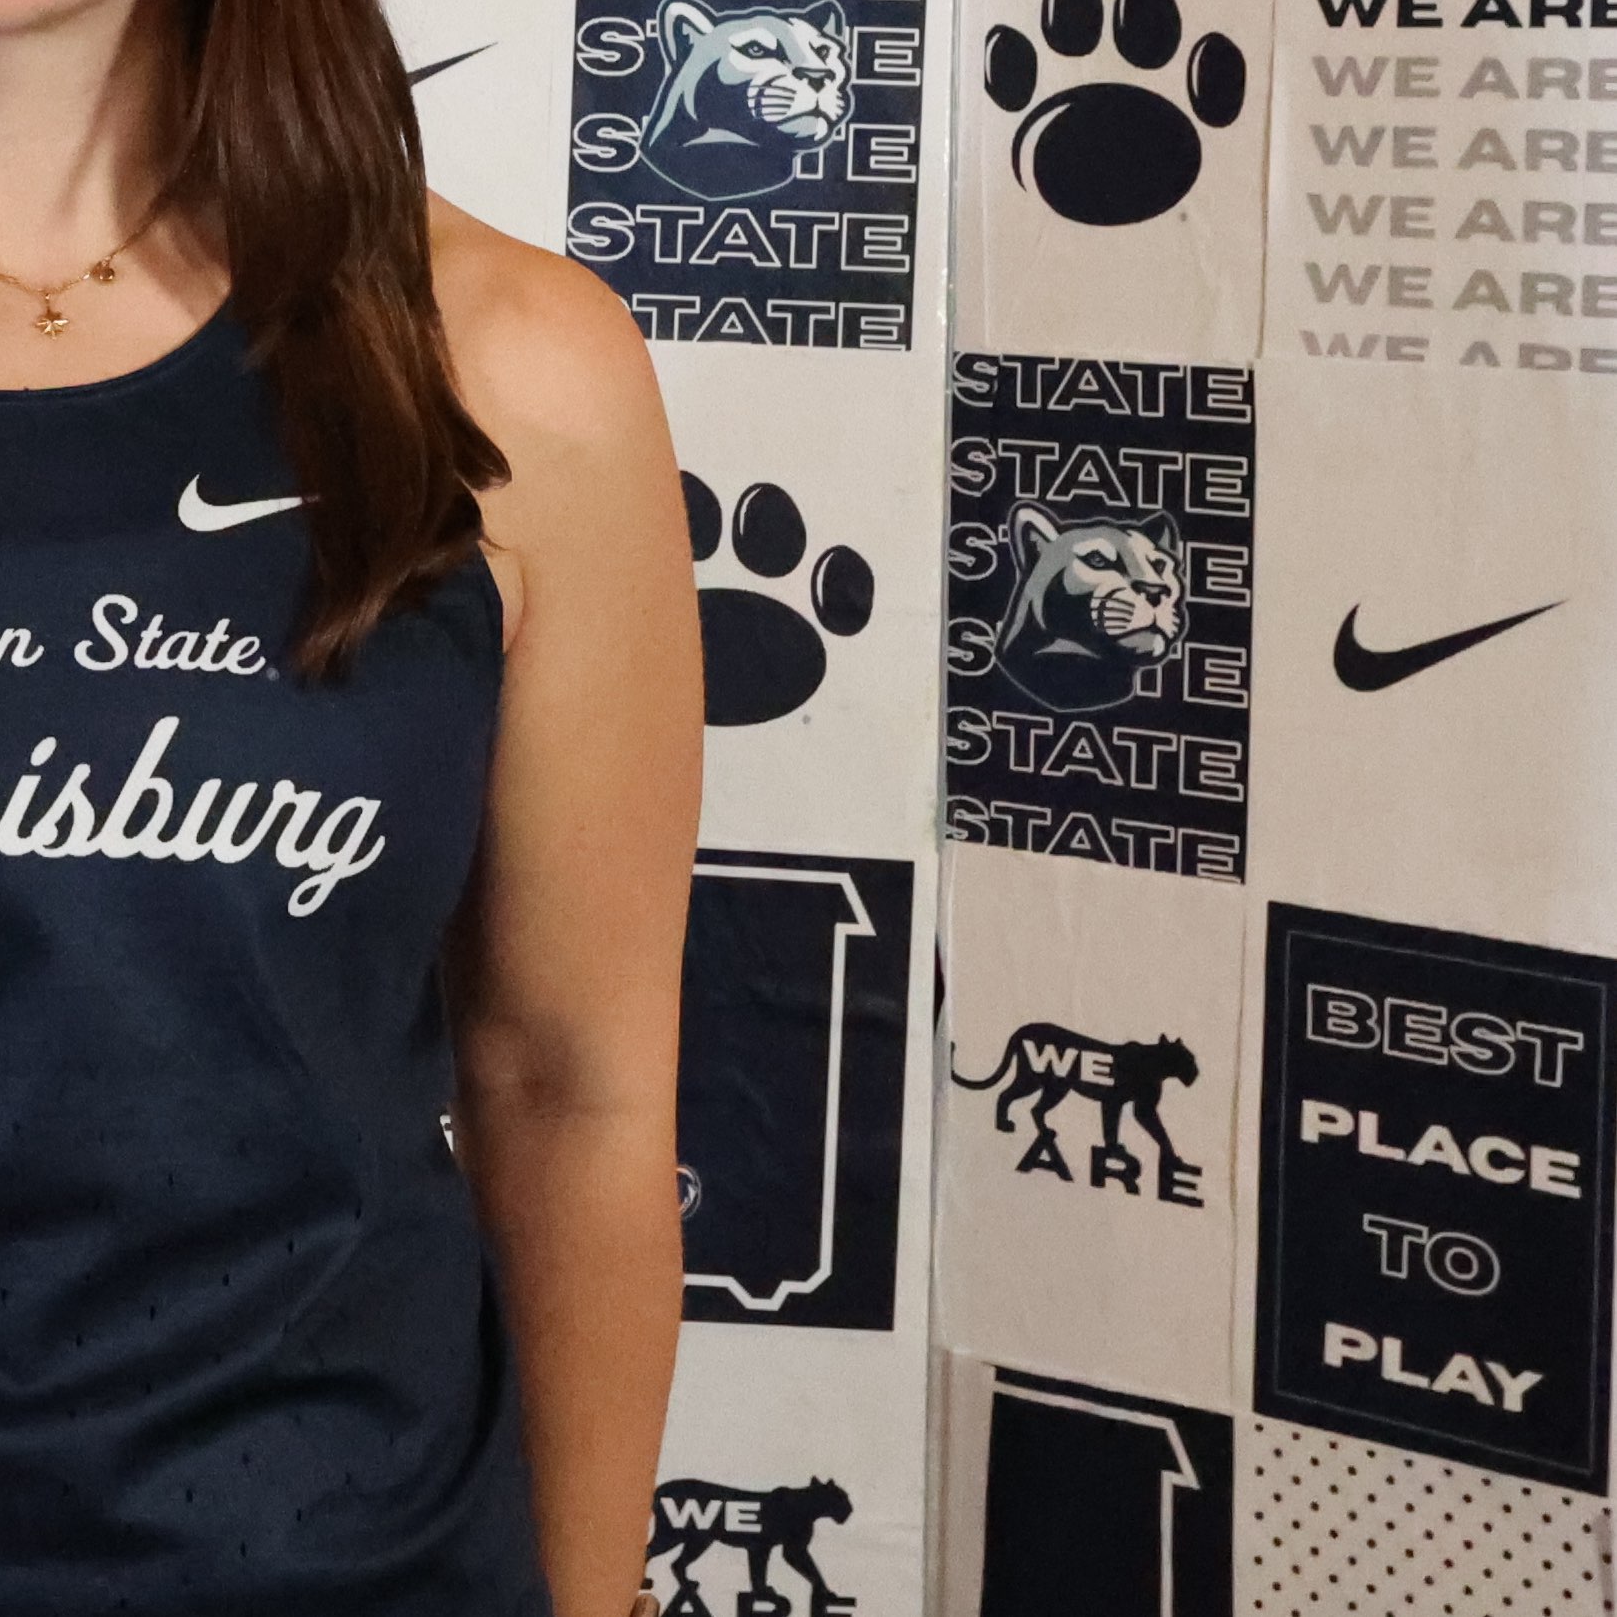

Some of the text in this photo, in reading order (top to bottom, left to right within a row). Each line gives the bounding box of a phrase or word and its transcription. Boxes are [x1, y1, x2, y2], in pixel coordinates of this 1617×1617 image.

[1311, 55, 1440, 98] WE
[1310, 125, 1438, 169] WE
[567, 202, 910, 273] STATE
[1307, 193, 1617, 246] WE ARE
[623, 294, 905, 351] TATE
[1304, 262, 1617, 318] WE ARE
[953, 350, 1251, 423] STATE
[950, 436, 1250, 517] STATE
[74, 594, 266, 675] State
[946, 706, 1244, 802] STATE
[946, 794, 1243, 883] STATE
[1022, 1039, 1116, 1087] WE
[1307, 983, 1583, 1088] BEST
[1014, 1135, 1205, 1208] ARE
[1299, 1099, 1582, 1200] PLACE
[1362, 1212, 1501, 1296] TO
[1322, 1322, 1544, 1414] PLAY
[660, 1497, 762, 1533] WE
